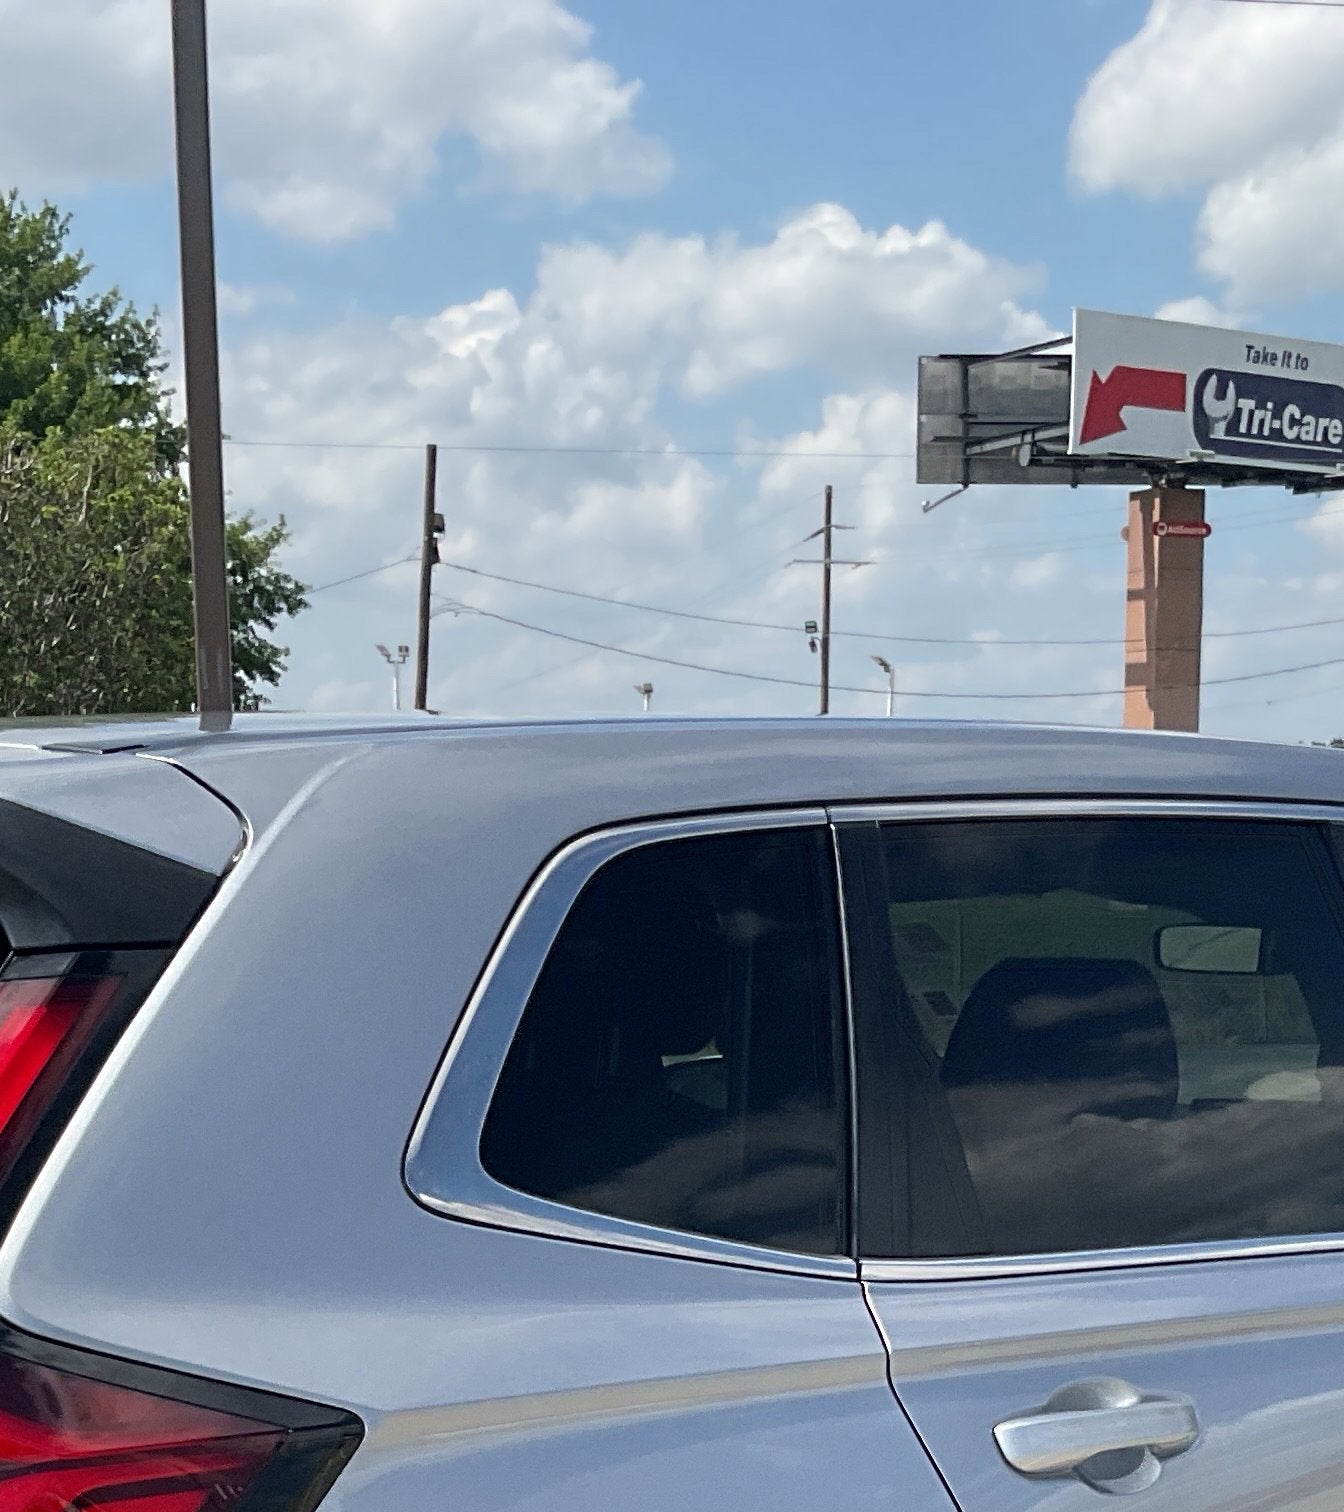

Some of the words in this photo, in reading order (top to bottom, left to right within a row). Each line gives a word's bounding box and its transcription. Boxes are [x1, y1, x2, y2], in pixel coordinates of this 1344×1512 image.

[1245, 344, 1278, 367] Take
[1281, 350, 1292, 369] It
[1294, 353, 1309, 371] to
[1238, 398, 1343, 444] Tri-Care
